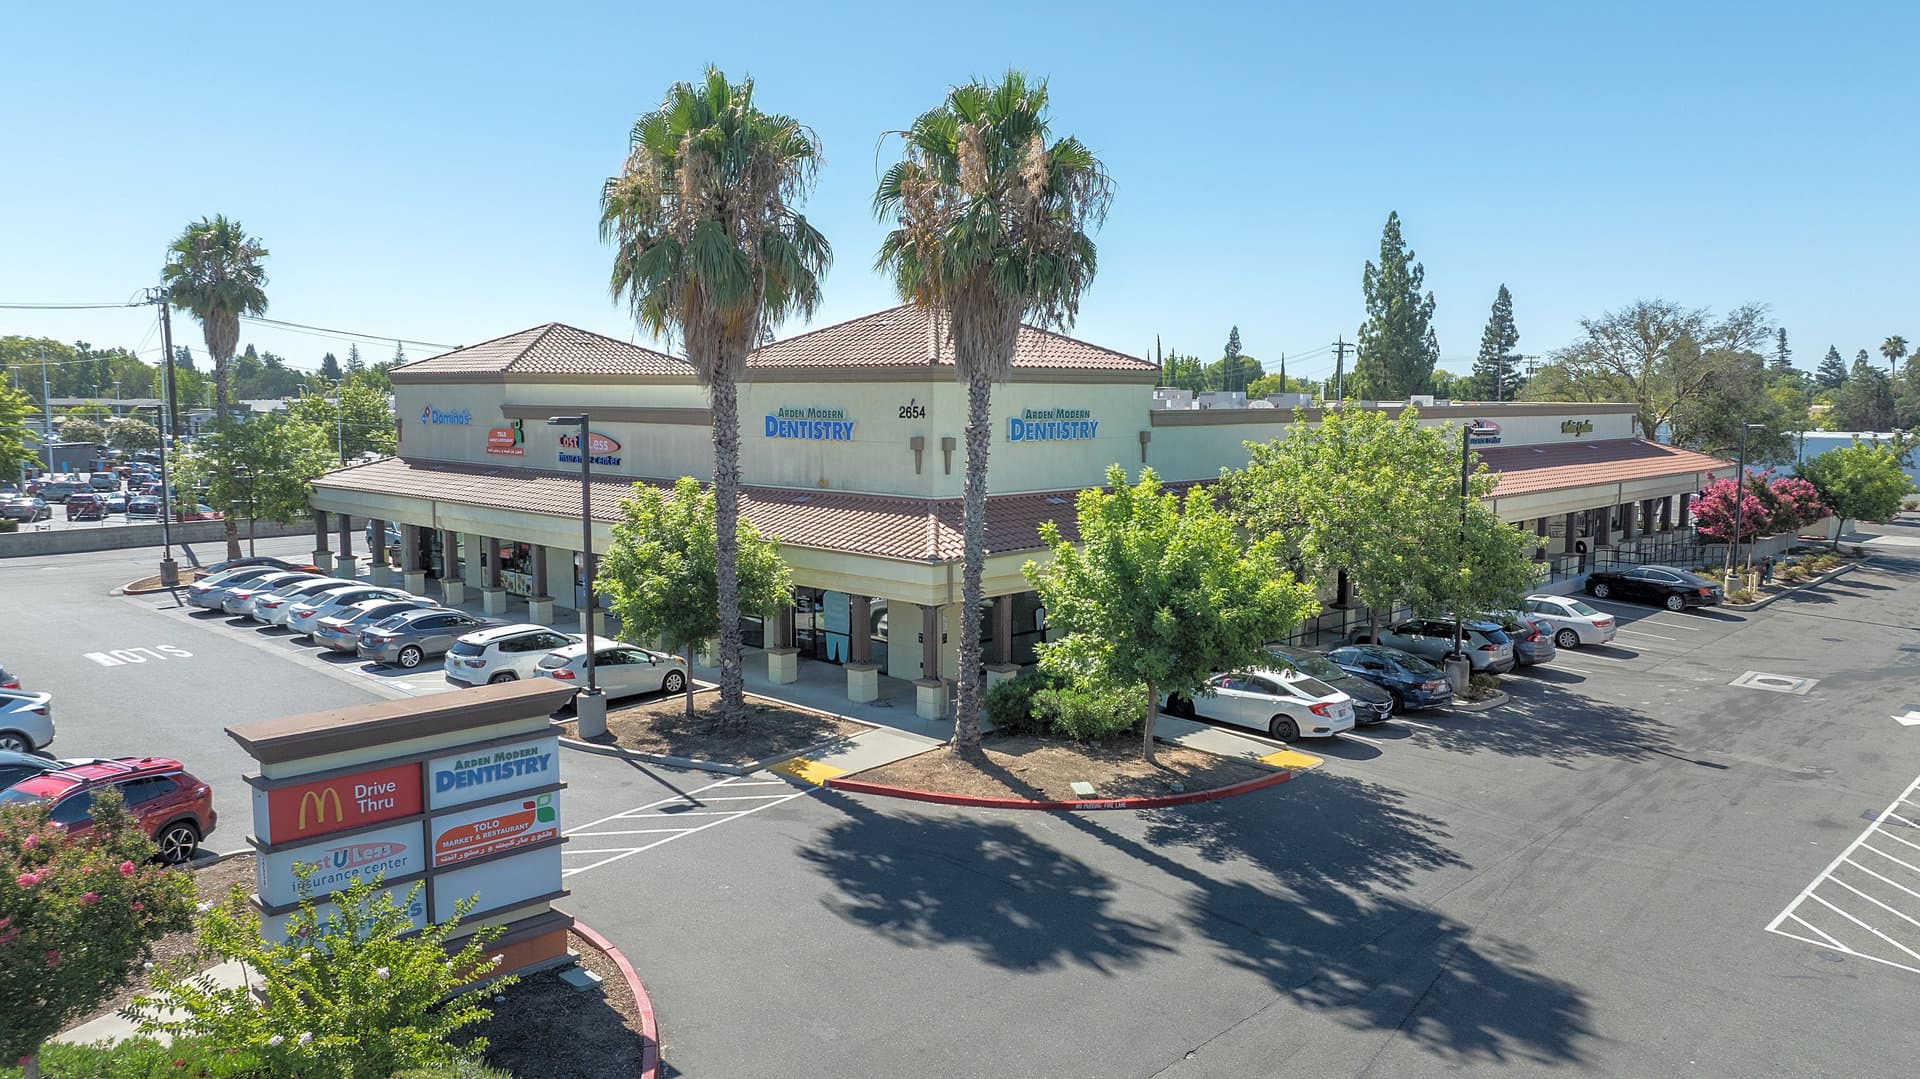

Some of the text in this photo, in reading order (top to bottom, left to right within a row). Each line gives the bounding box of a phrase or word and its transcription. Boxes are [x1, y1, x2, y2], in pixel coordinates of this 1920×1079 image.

[432, 409, 471, 425] Domino's
[778, 407, 844, 419] ARDEN MODERN
[899, 406, 926, 419] 2654
[1025, 409, 1090, 420] ARDEN MODERN
[765, 415, 855, 441] DENTISTRY
[1010, 418, 1099, 441] DENTISTRY
[559, 452, 595, 464] insurae
[454, 746, 538, 771] ARDEN MODERN
[435, 753, 551, 793] DENTISTRY
[354, 782, 396, 799] Drive
[357, 797, 394, 814] Thru
[442, 835, 474, 848] MARKET
[483, 822, 529, 839] RESTAURANT
[473, 820, 500, 833] TOLO
[333, 849, 348, 868] U
[352, 844, 392, 863] Less
[364, 856, 408, 875] center
